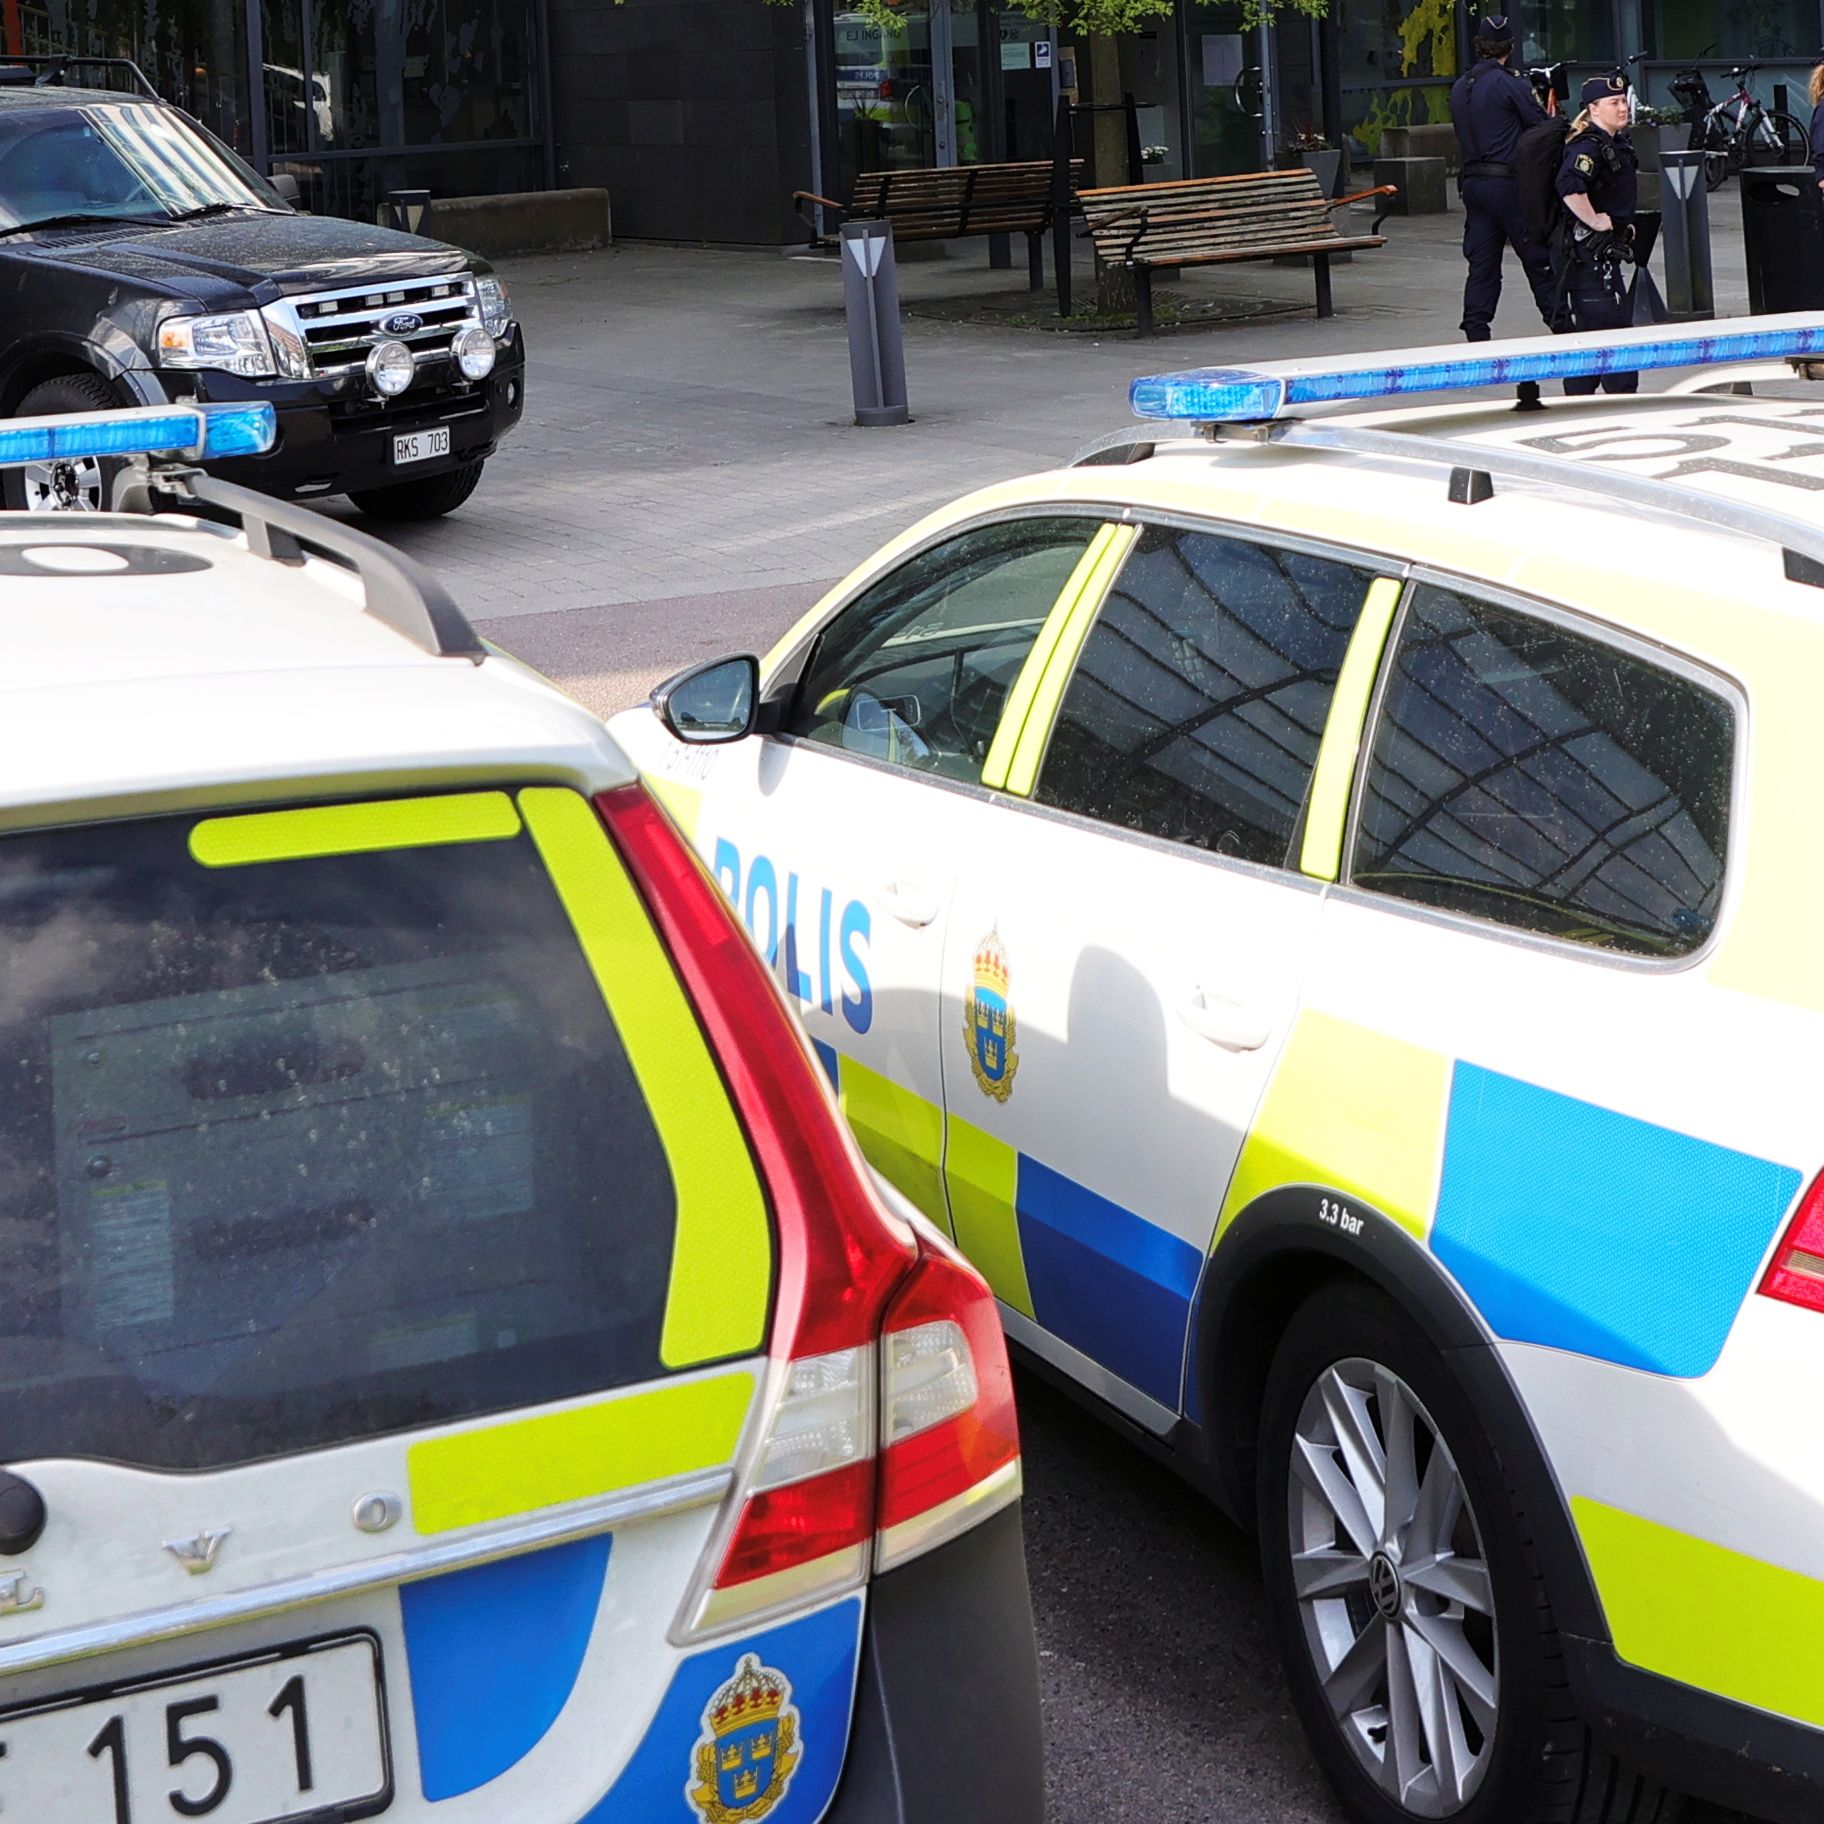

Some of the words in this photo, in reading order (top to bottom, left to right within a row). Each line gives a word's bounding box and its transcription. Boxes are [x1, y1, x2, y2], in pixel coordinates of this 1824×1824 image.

[393, 317, 415, 331] Ford
[396, 437, 418, 461] RKS
[427, 430, 449, 455] 703
[714, 836, 873, 1035] POLIS
[1318, 1198, 1339, 1226] 3.3
[1340, 1206, 1364, 1236] bar
[87, 1674, 314, 1824] 151
